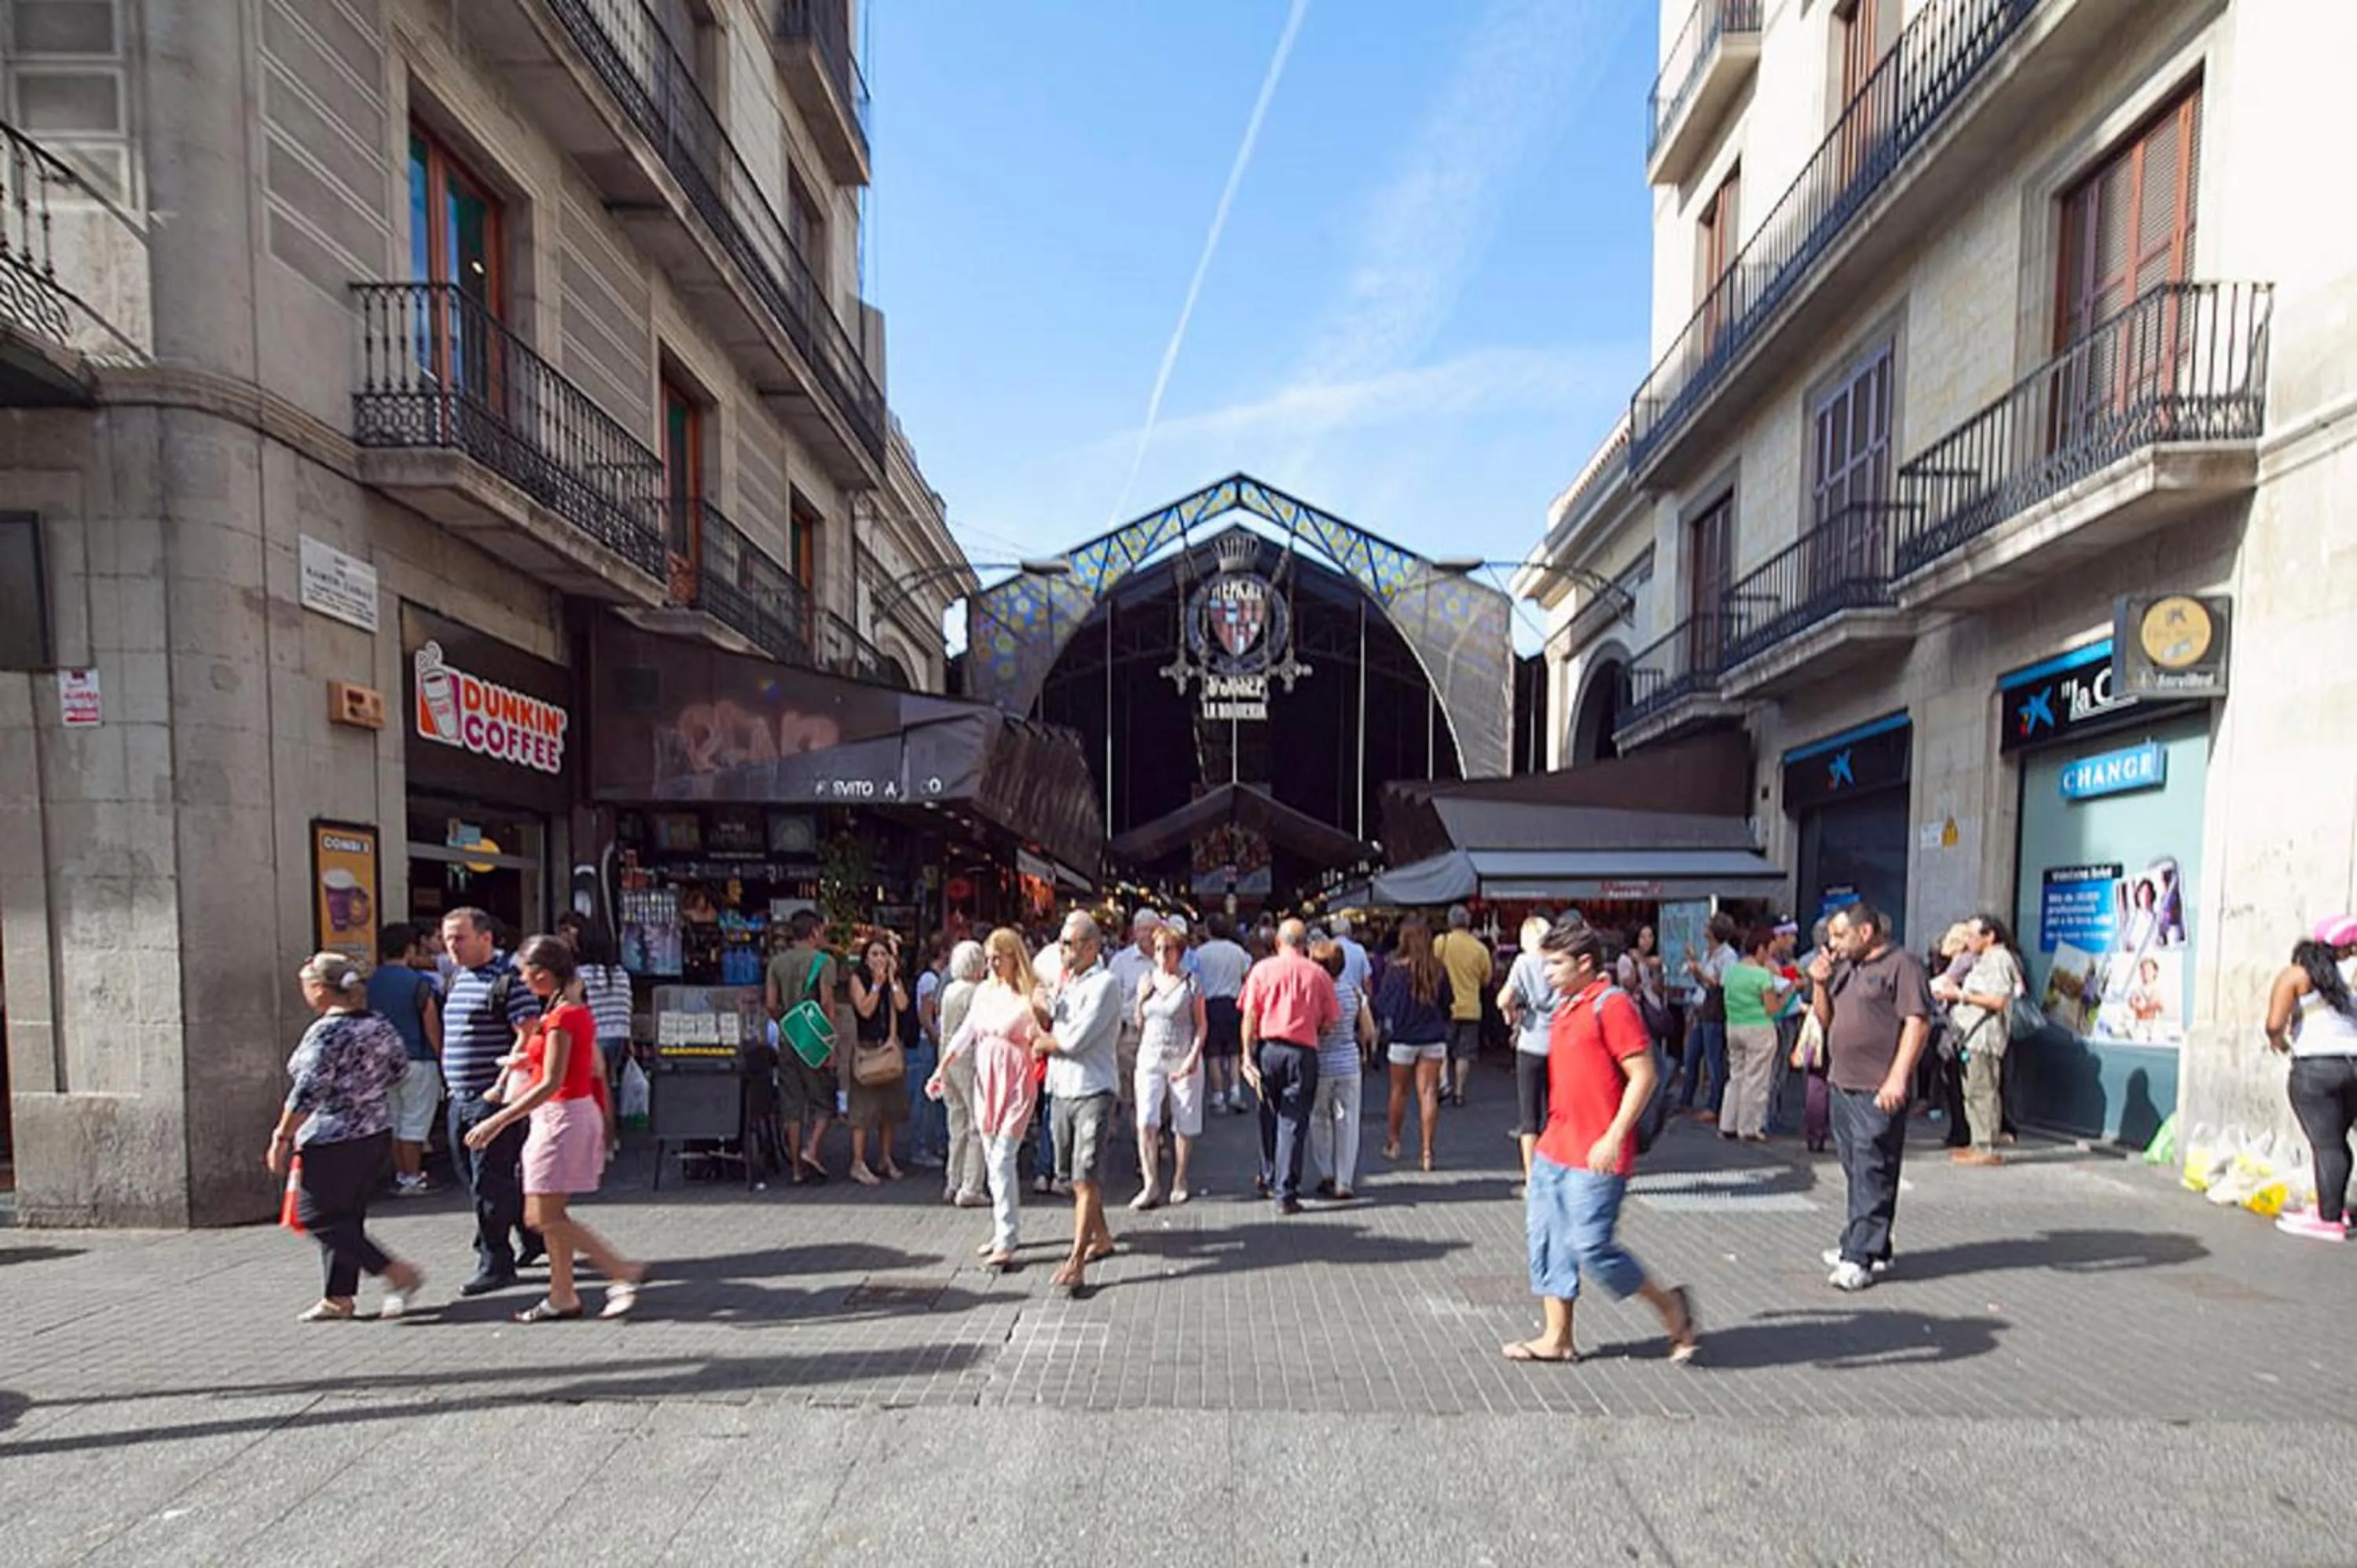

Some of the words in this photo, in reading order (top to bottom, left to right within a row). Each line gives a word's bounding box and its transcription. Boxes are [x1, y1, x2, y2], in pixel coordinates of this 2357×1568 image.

[463, 677, 566, 738] DUNKIN'
[464, 714, 559, 768] COFFEE
[2062, 751, 2152, 790] CHANGE
